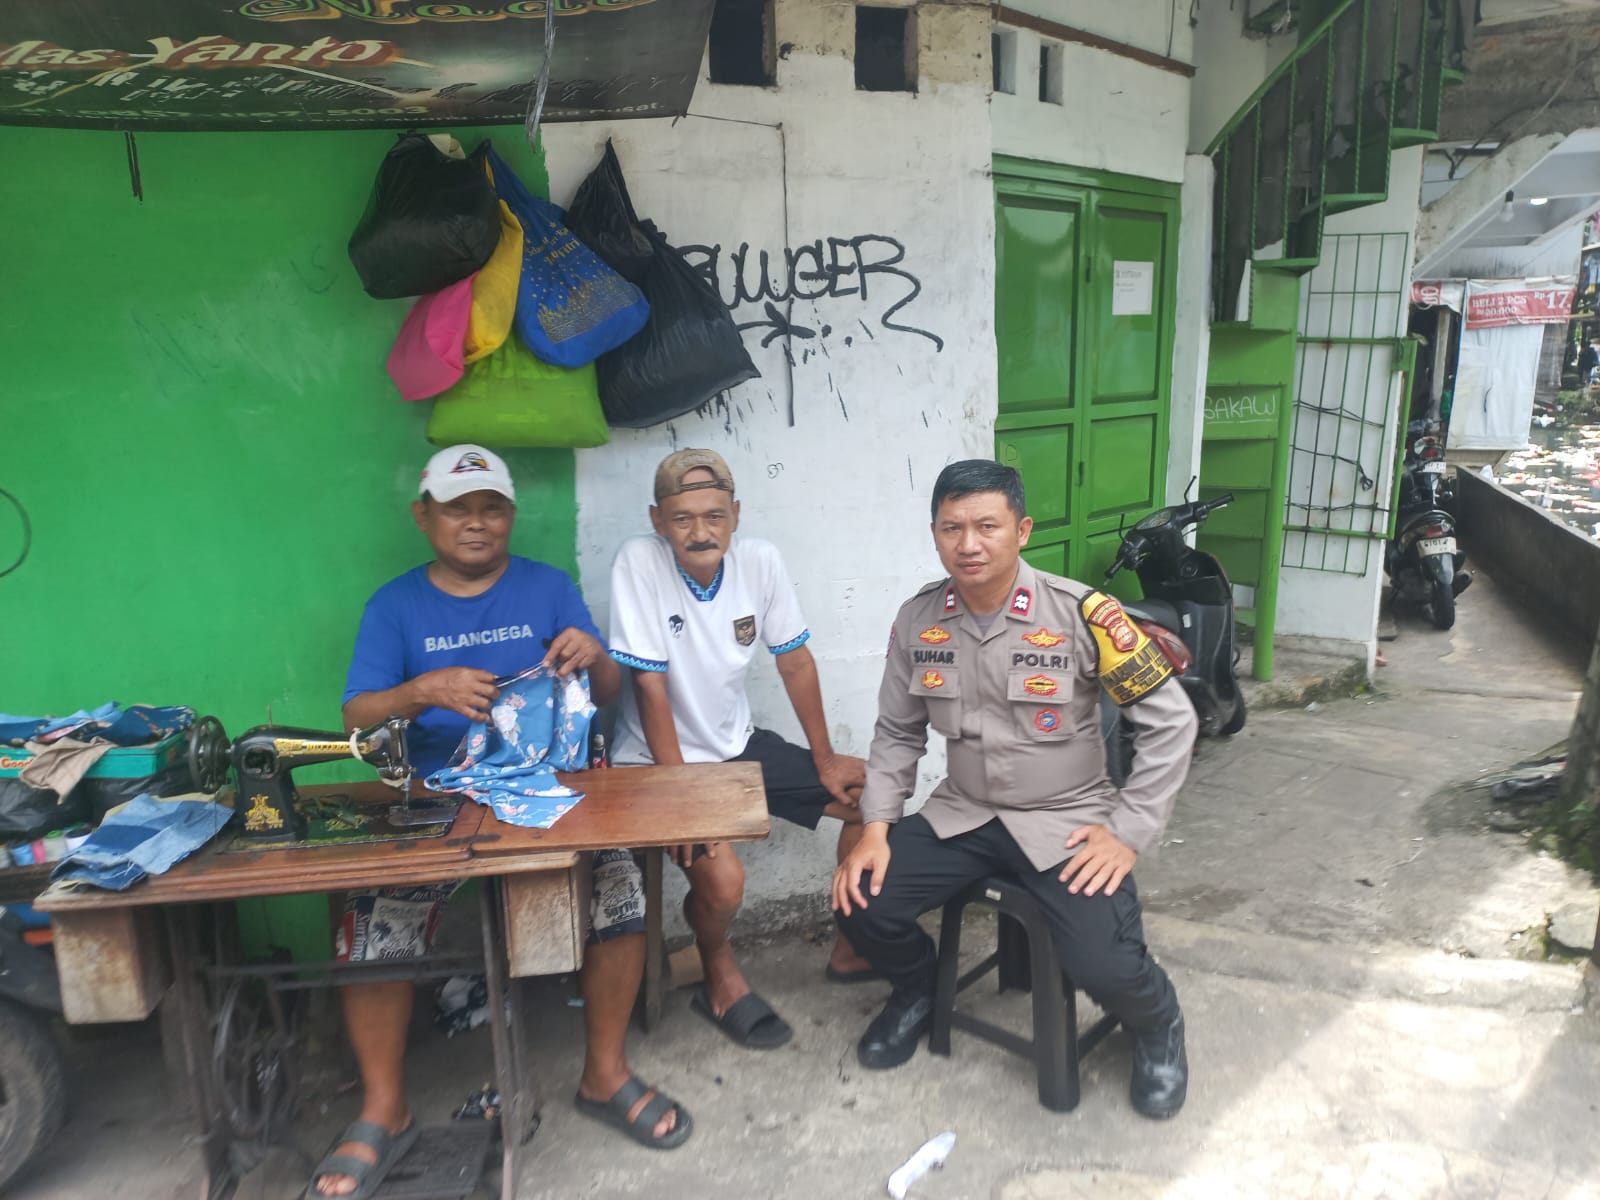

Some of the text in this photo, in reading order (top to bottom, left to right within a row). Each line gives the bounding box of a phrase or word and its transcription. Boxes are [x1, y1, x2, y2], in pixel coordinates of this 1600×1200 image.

[147, 35, 390, 64] Yanto
[424, 624, 534, 652] BALANCIEGA
[914, 650, 954, 664] SUHAR
[1012, 653, 1068, 670] POLRI
